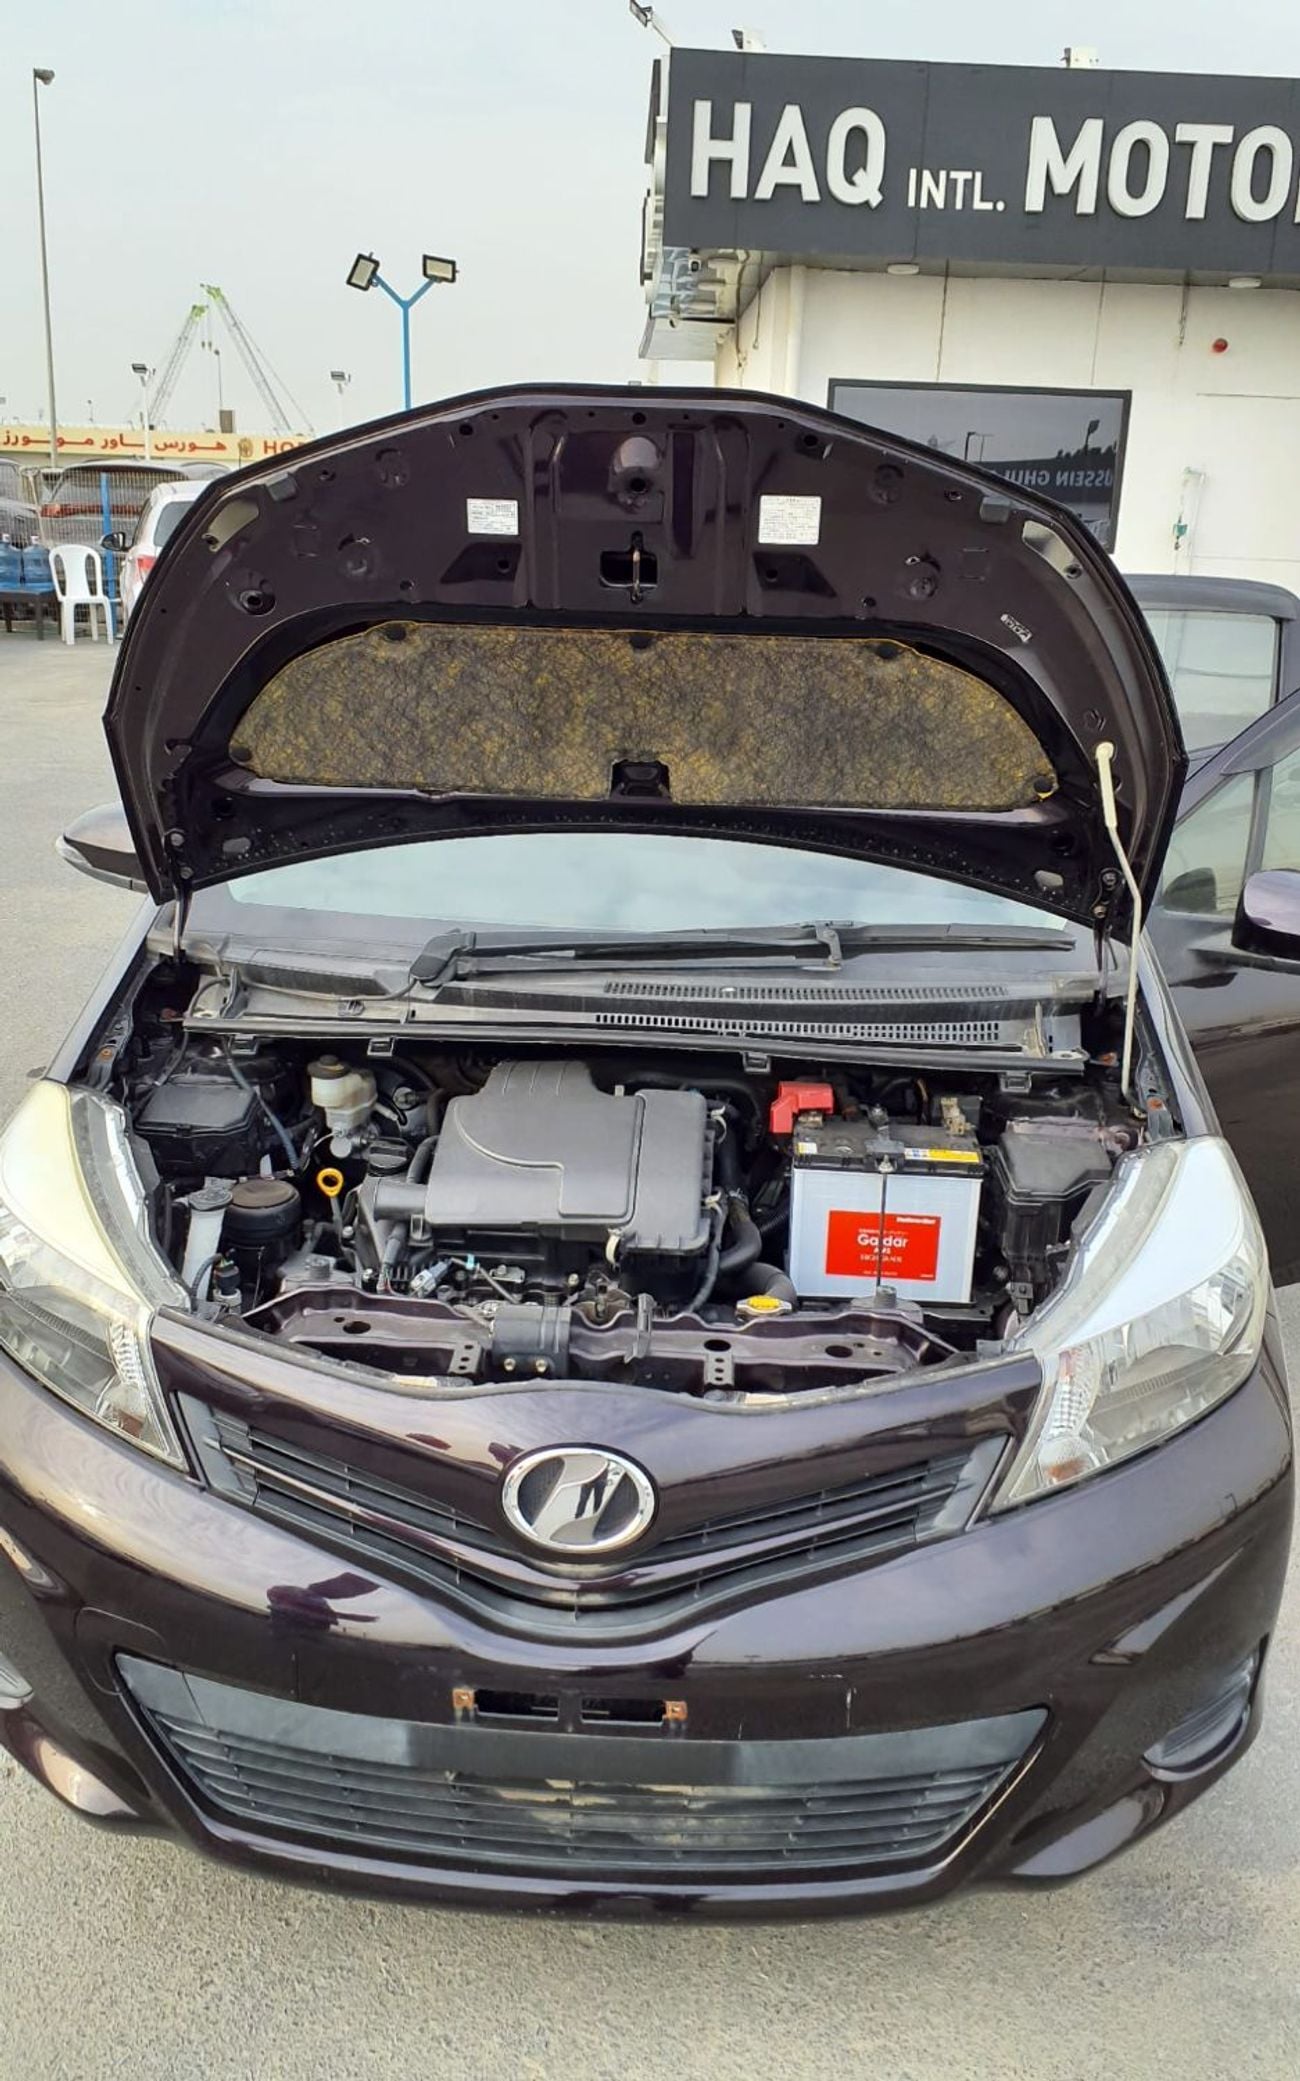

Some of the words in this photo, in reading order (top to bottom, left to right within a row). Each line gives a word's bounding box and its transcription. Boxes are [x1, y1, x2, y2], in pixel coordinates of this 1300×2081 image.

[690, 100, 886, 208] HAQ
[907, 167, 1005, 212] INTL.
[1024, 116, 1300, 223] MOTO
